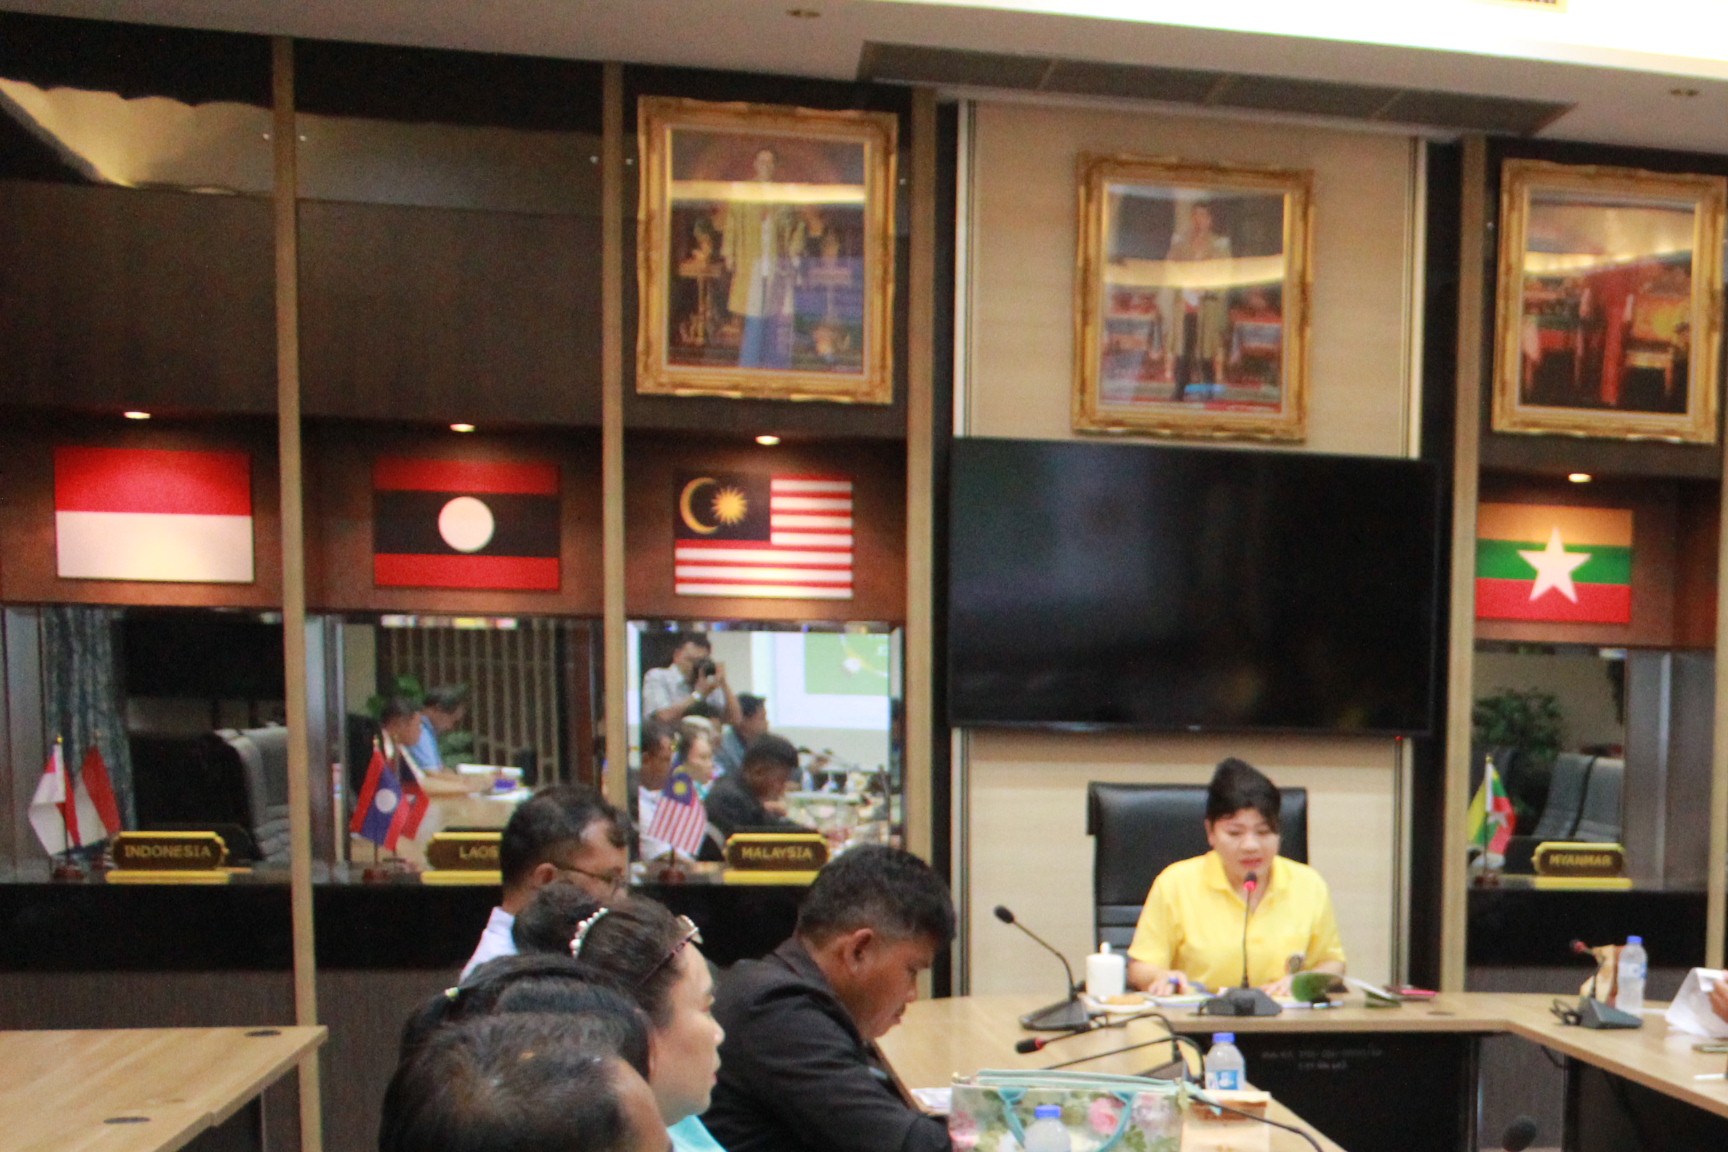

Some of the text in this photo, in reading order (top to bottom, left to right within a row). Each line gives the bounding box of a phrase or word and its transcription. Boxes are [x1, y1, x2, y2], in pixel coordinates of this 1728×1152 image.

[124, 844, 212, 858] INDONESIA
[459, 845, 499, 859] LAOS
[741, 846, 813, 860] MALAYSIA
[1548, 853, 1613, 867] MYANMAR
